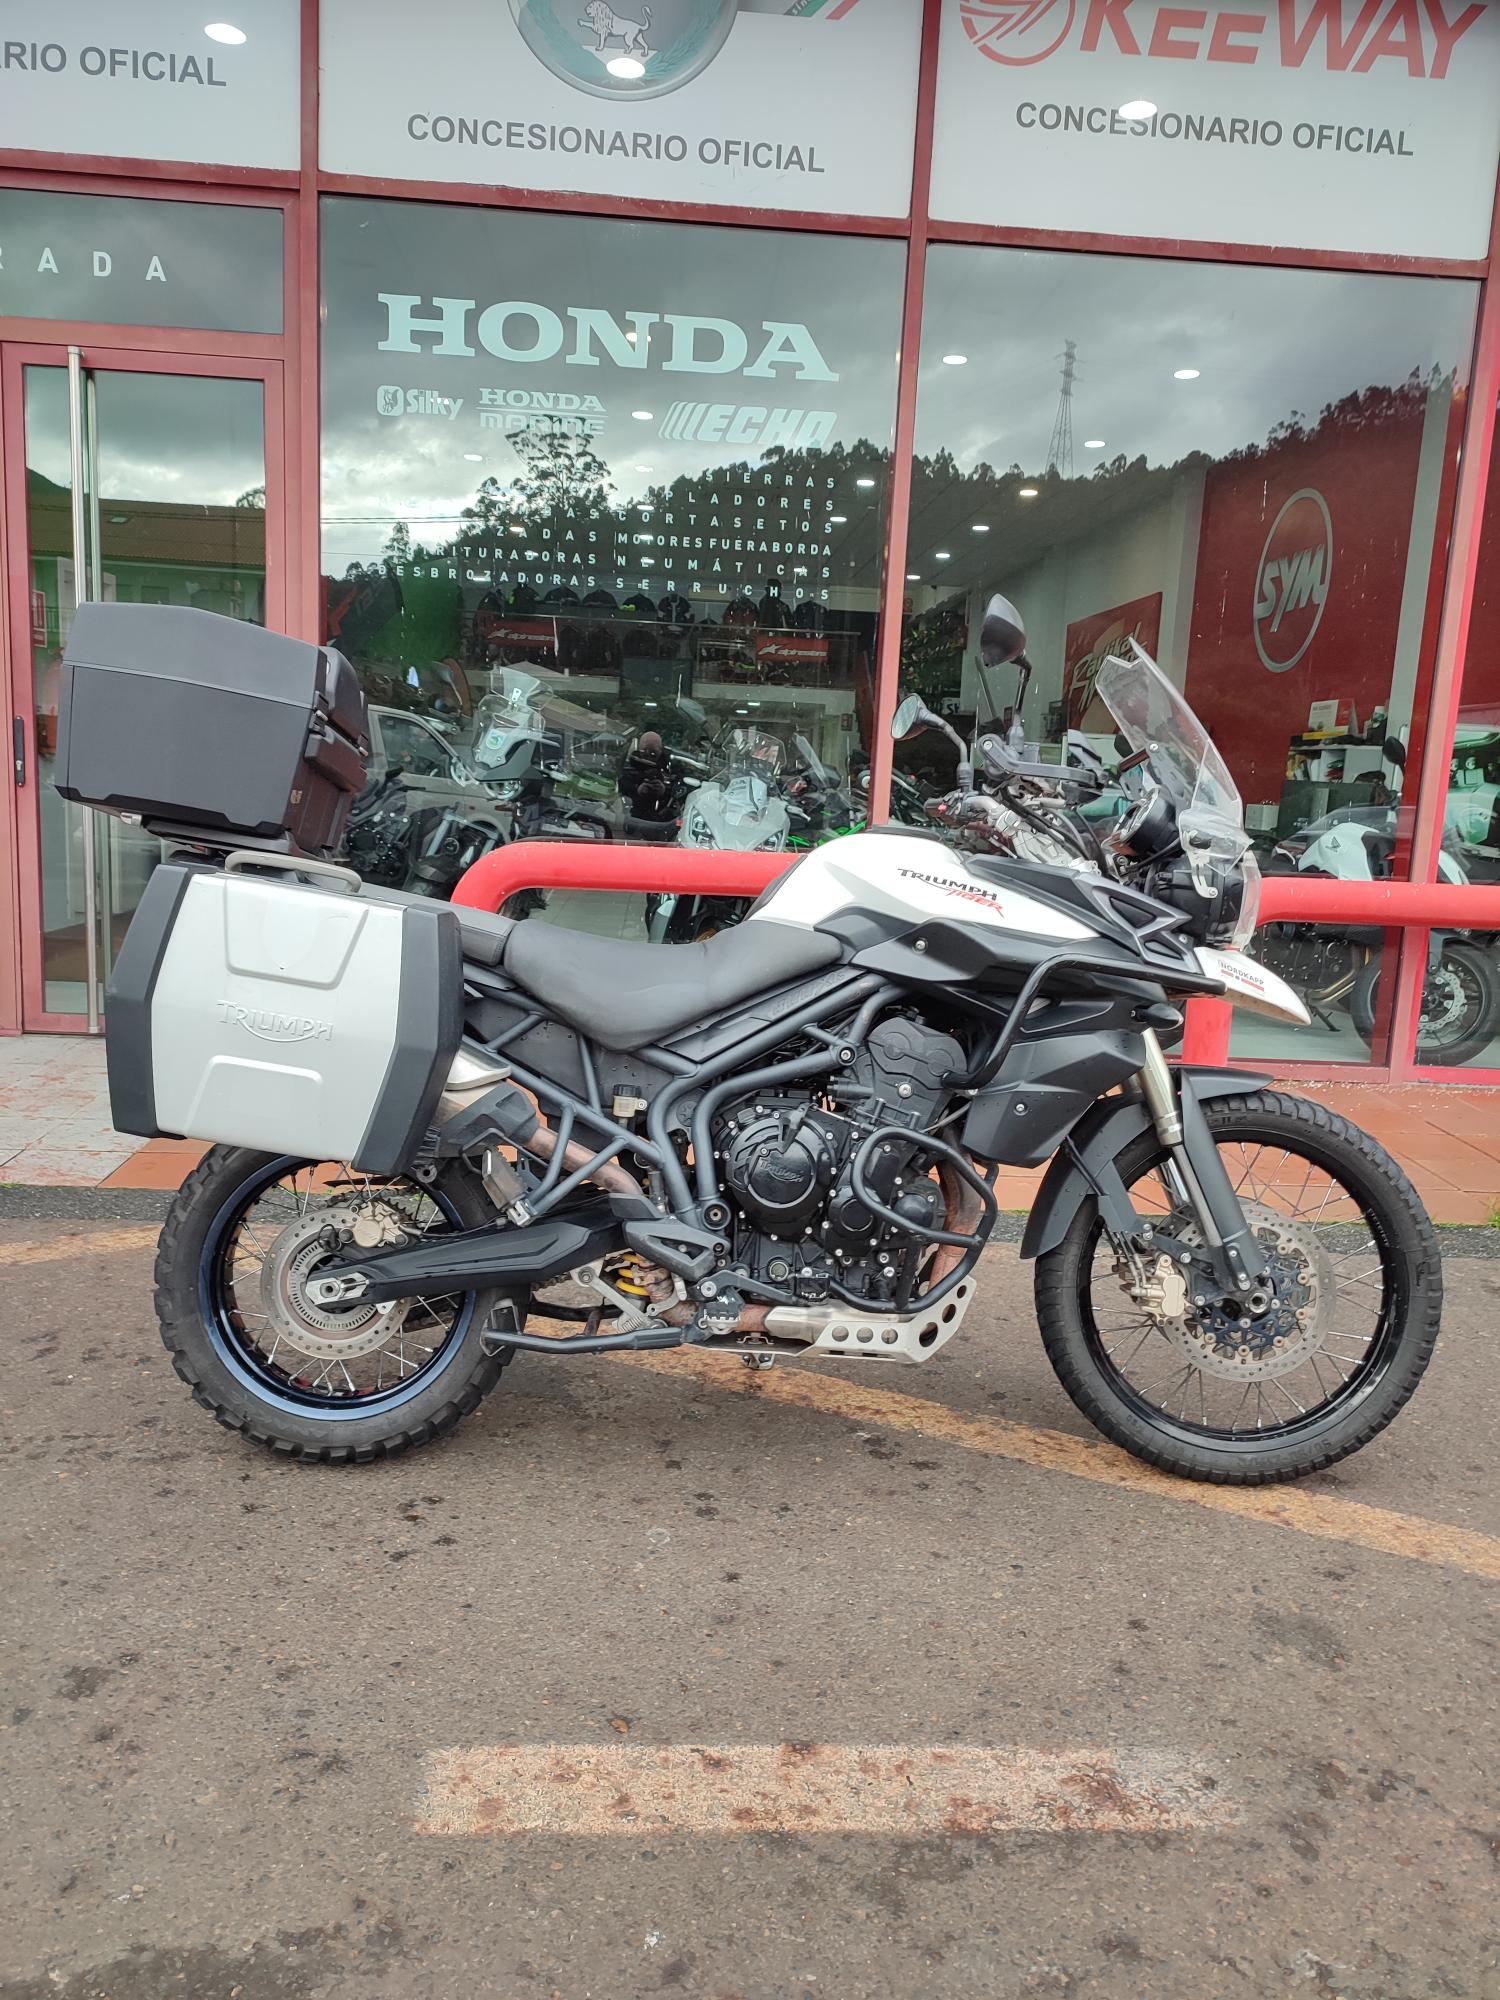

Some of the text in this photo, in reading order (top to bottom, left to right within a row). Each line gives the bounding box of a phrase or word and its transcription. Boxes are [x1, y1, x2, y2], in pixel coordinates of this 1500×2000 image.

[0, 41, 227, 87] RIO OFICIAL
[406, 113, 826, 173] CONCESIONARIO OFICIAL
[1016, 101, 1414, 156] CONCESIONARIO OFICIAL
[0, 247, 167, 282] ADA
[377, 292, 839, 382] HONDA
[406, 388, 464, 420] Silky
[479, 387, 607, 412] HONDA
[697, 403, 838, 449] ECHO
[618, 511, 832, 534] CORTASETOS
[379, 565, 596, 587] DESBROZADORAS
[616, 578, 829, 600] SERRUCHOS
[1255, 543, 1328, 632] SYM
[897, 868, 998, 901] TRIUMPH
[945, 888, 1005, 919] TIGER
[217, 999, 334, 1041] TRIUMPH
